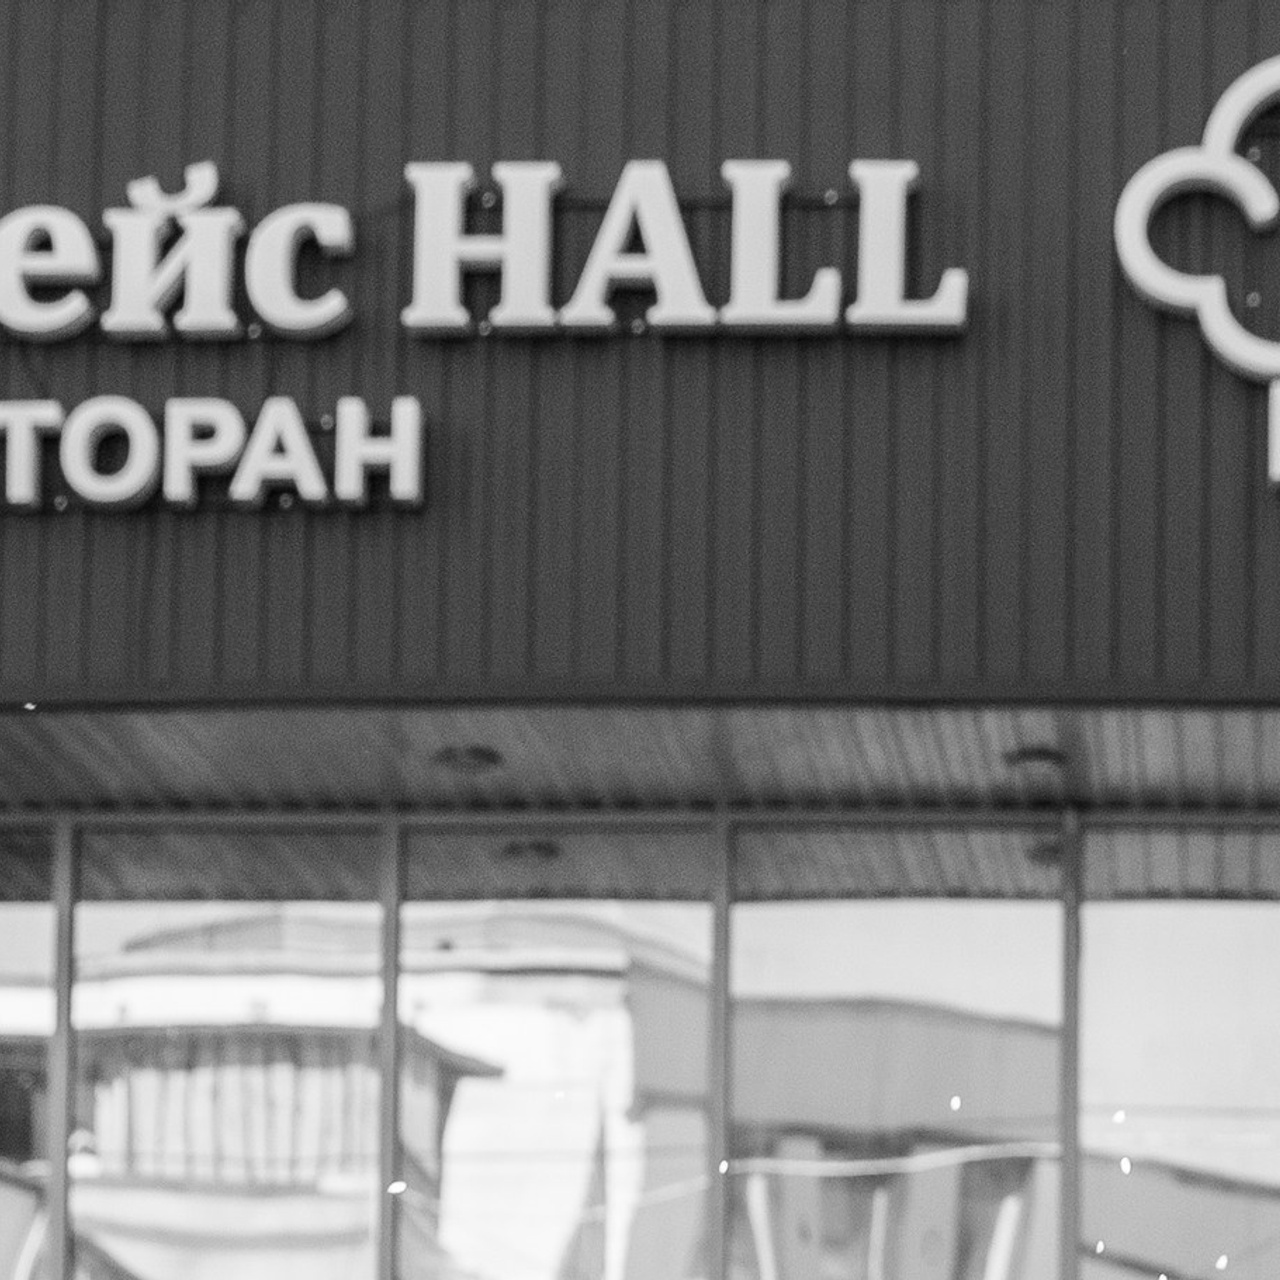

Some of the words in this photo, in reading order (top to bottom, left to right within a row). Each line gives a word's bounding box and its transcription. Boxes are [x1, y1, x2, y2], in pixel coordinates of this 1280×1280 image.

[0, 158, 354, 335] ейс
[401, 158, 970, 330] HALL
[0, 394, 422, 506] ТОРАН
